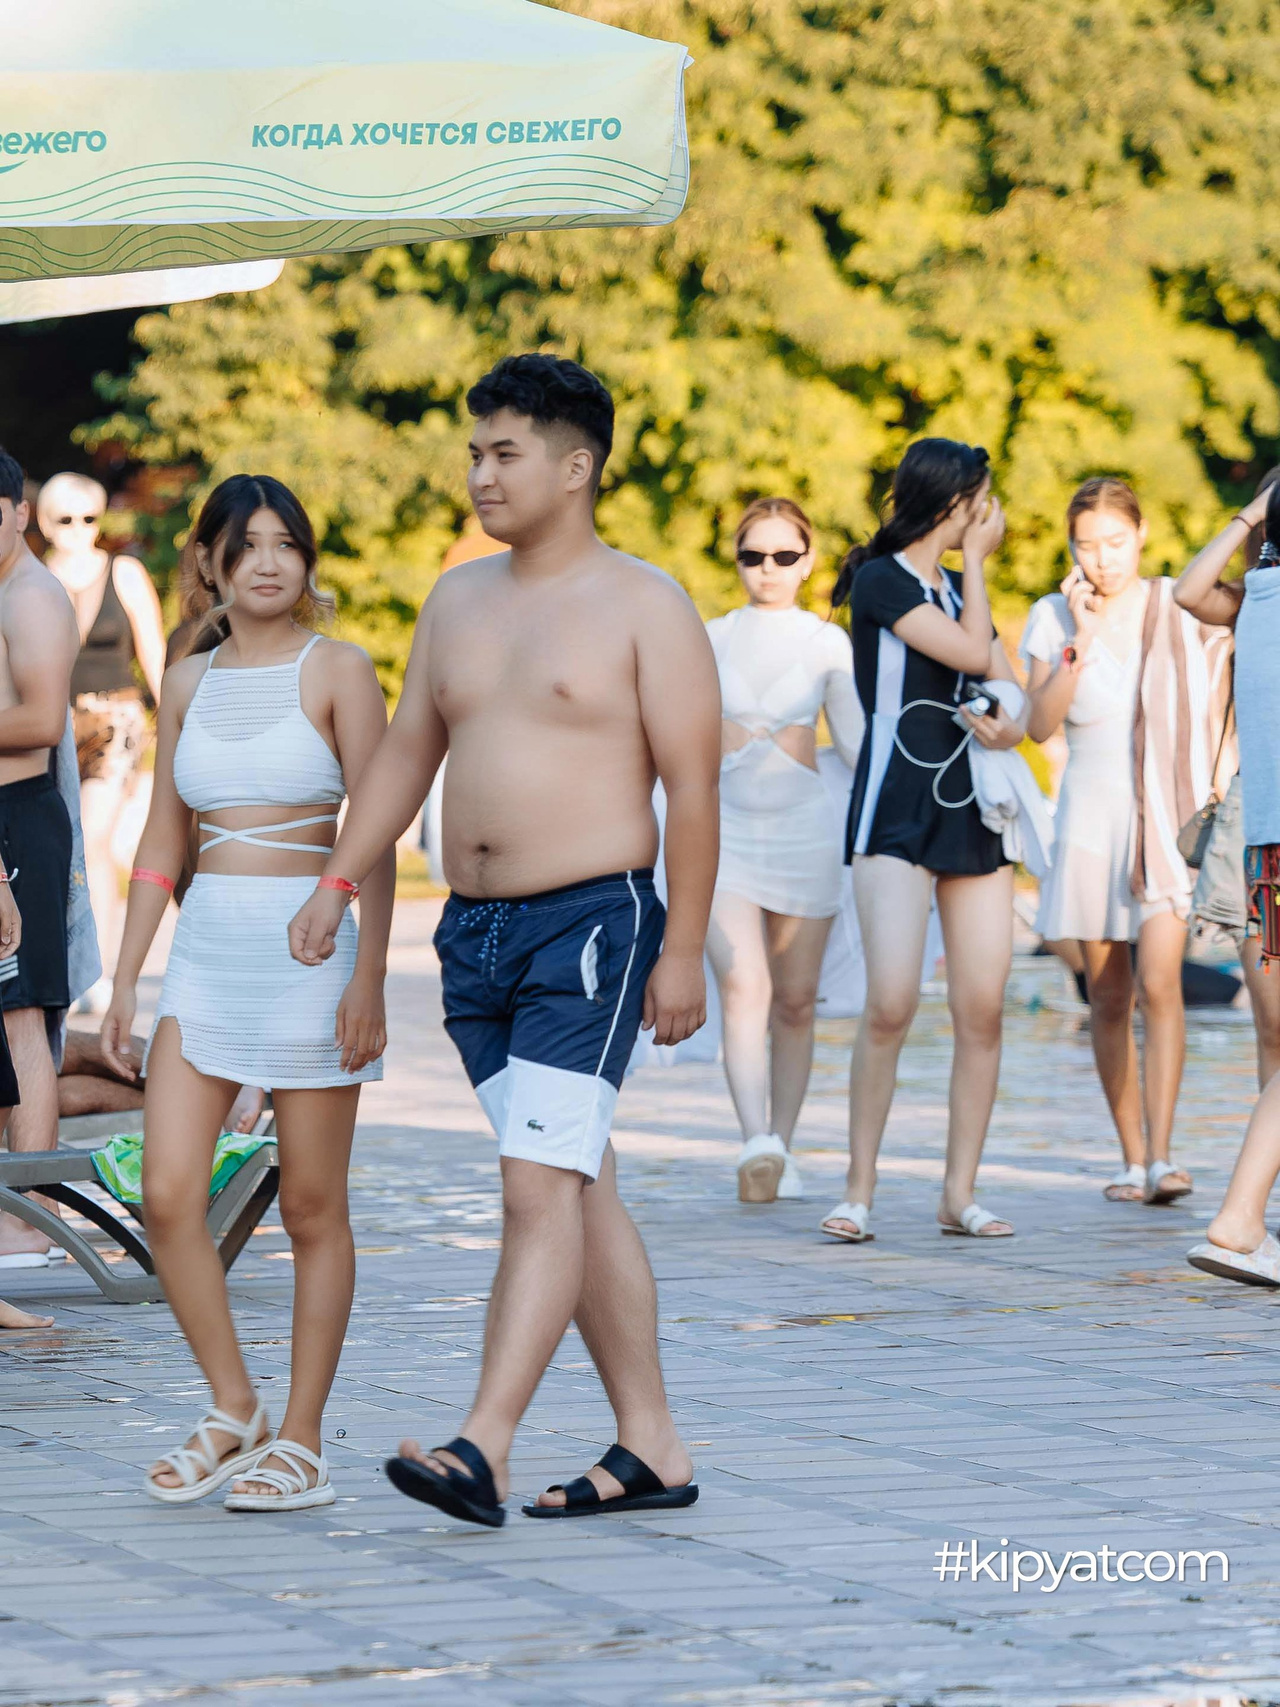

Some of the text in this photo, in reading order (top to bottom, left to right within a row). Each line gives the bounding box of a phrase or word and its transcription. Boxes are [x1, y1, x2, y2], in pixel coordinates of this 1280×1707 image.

[252, 117, 623, 150] КОГДА ХОЧЕТСЯ СВЕЖЕГО
